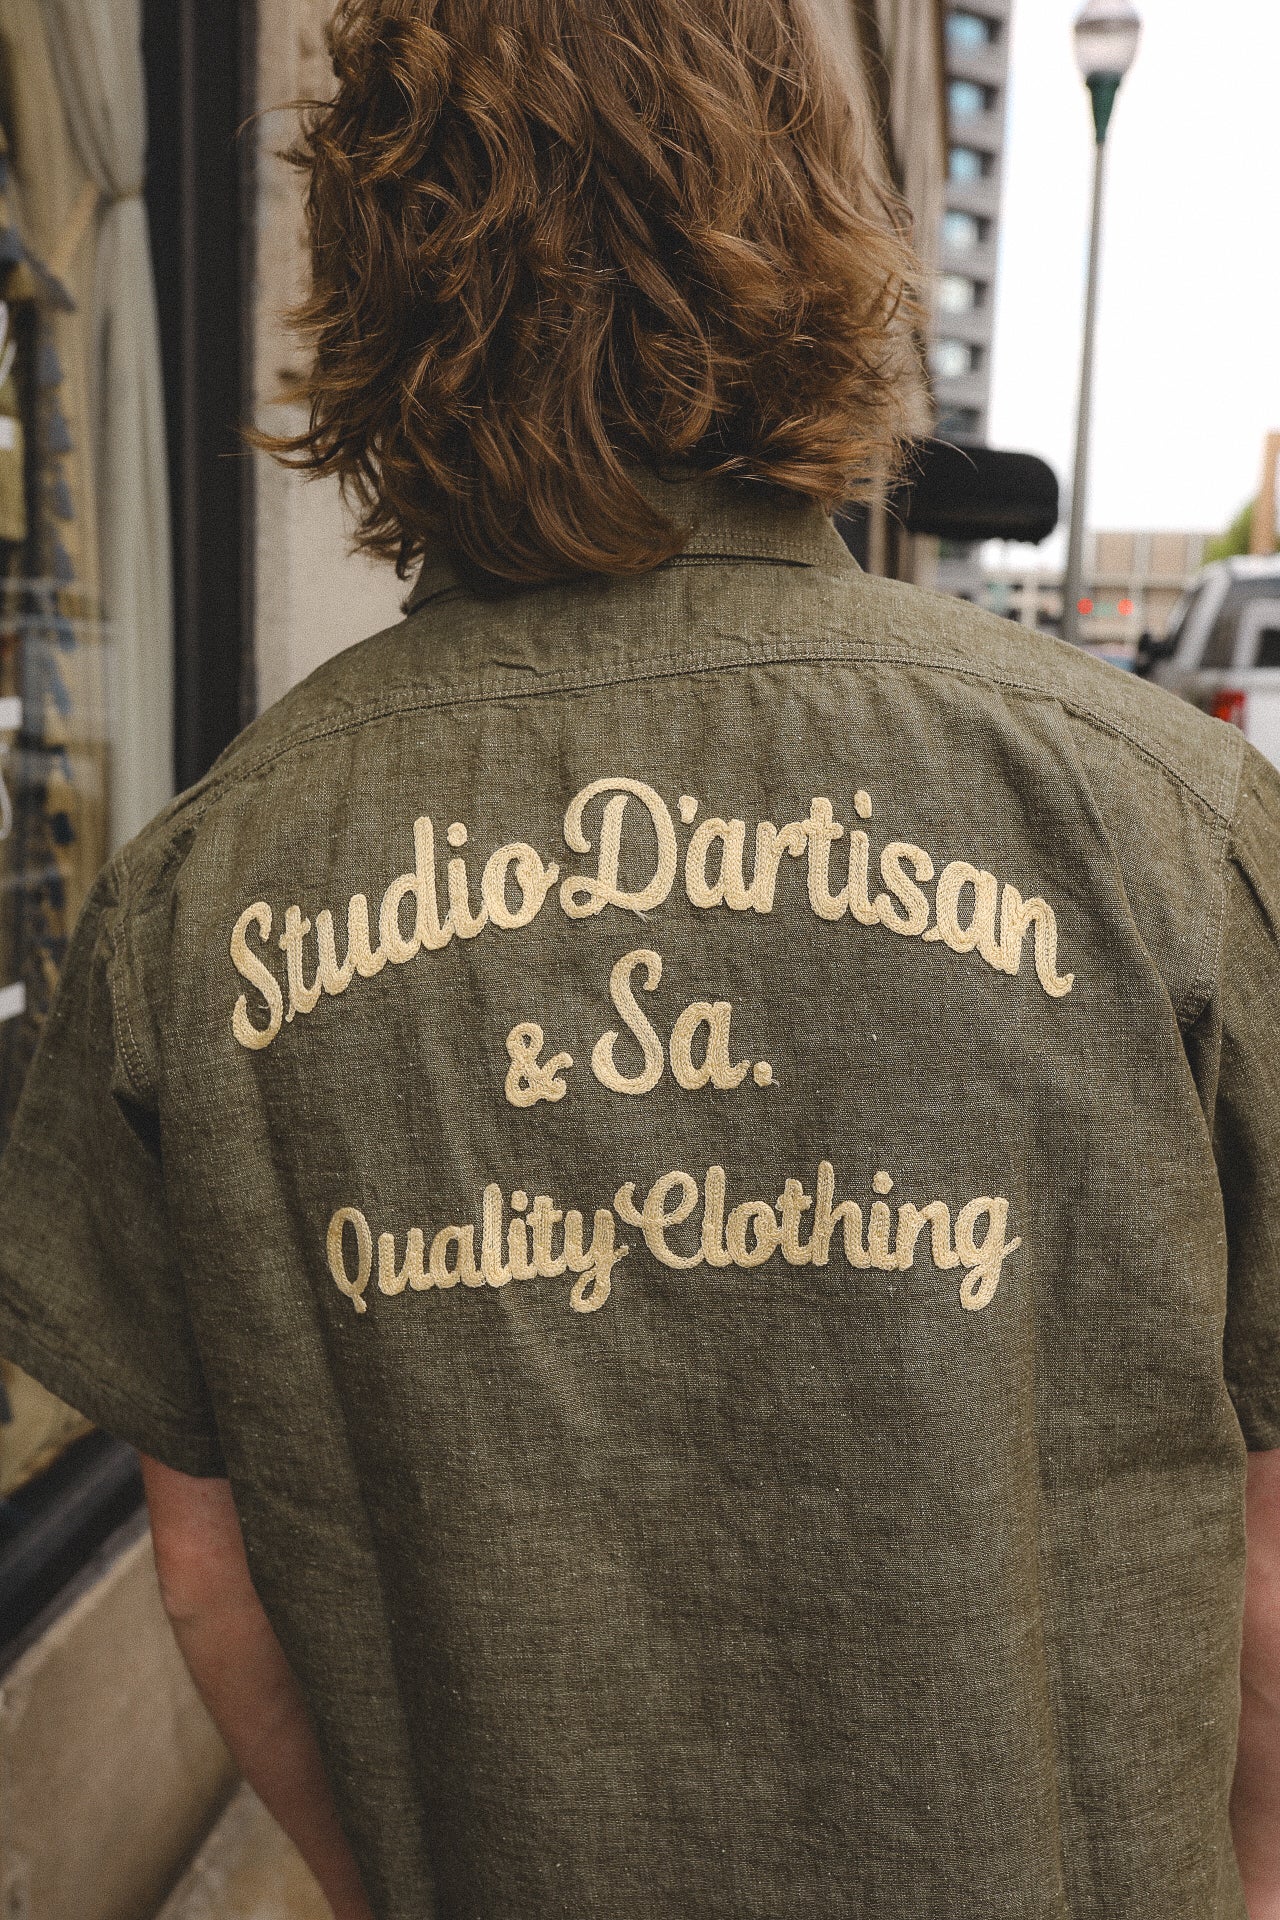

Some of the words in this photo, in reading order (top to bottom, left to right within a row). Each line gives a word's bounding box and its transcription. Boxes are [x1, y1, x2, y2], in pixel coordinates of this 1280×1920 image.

[229, 815, 561, 1051] Studio
[559, 776, 1075, 998] D'artisan
[505, 1022, 573, 1108] &
[591, 949, 776, 1095] Sa.
[326, 1182, 630, 1313] Quality
[613, 1160, 1022, 1311] Clothing
